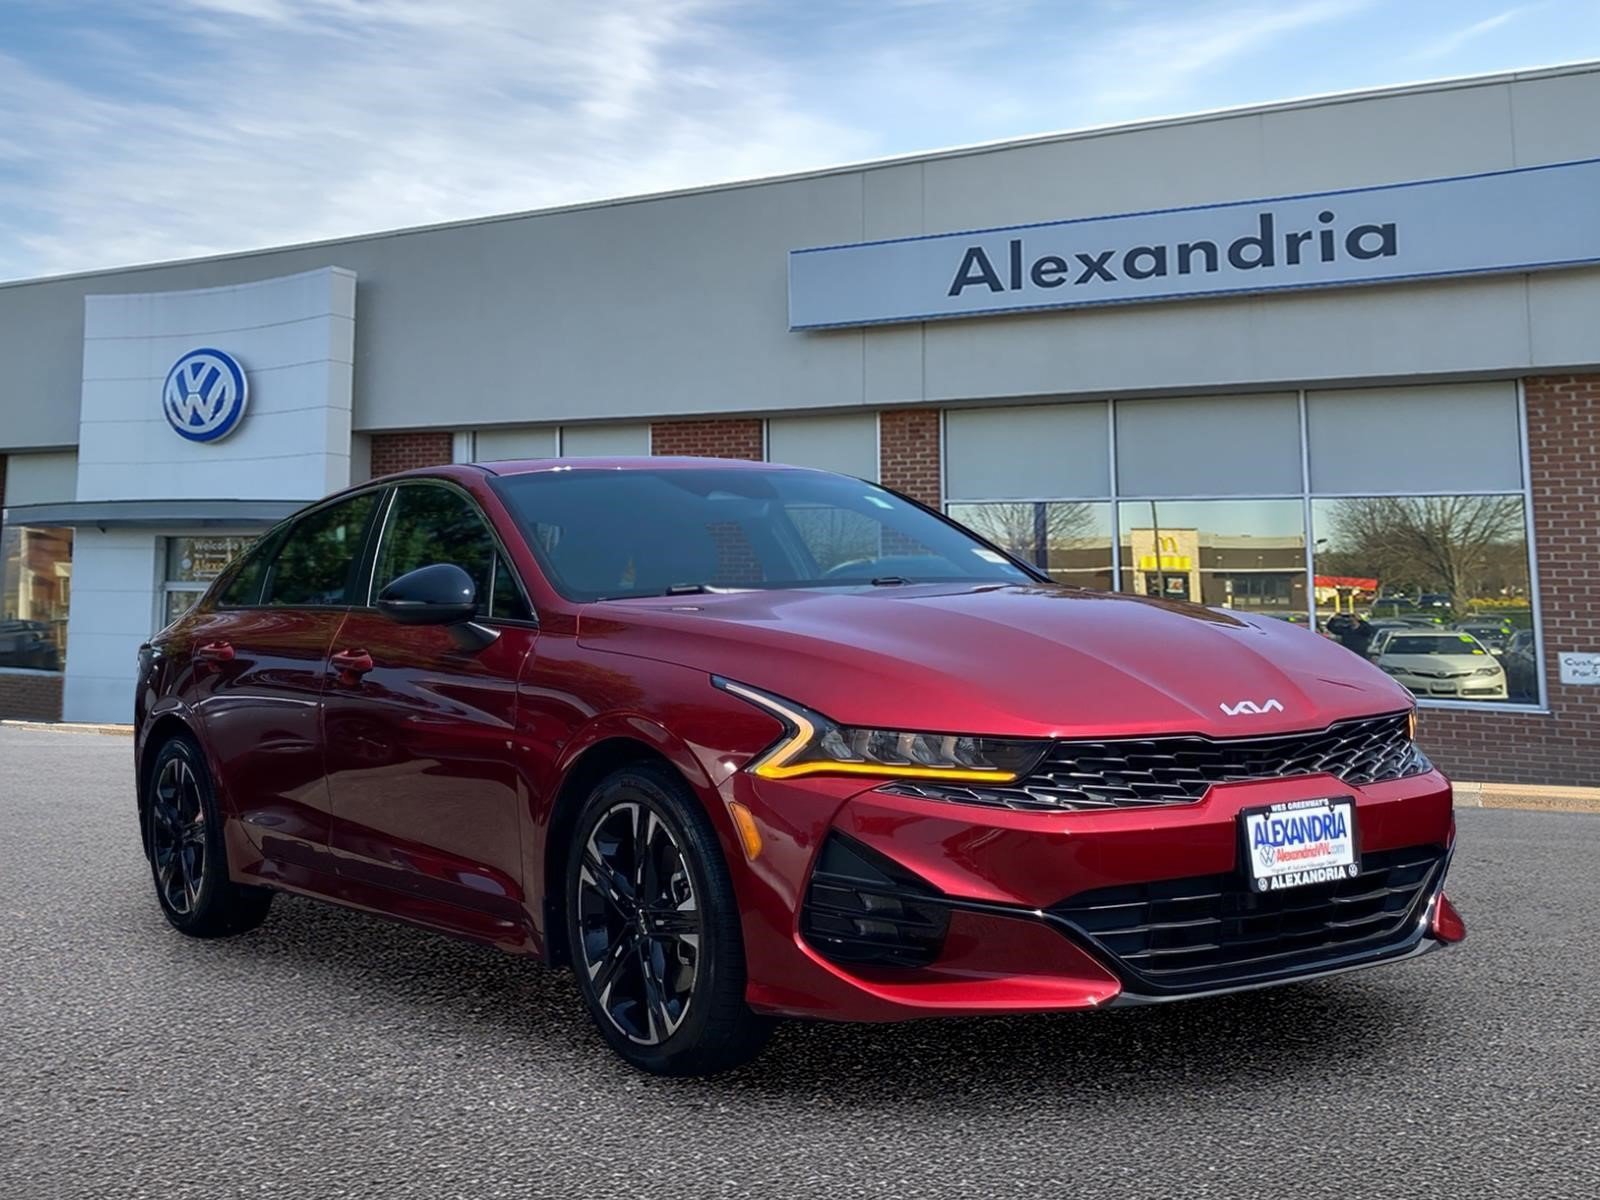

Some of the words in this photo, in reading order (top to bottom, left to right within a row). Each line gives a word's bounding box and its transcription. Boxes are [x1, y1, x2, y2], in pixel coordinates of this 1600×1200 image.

[947, 210, 1398, 297] Alexandria
[165, 353, 238, 434] VW
[1271, 803, 1286, 812] WES
[1254, 812, 1347, 850] ALEXANDRIA
[1271, 866, 1346, 890] ALEXANDRIA
